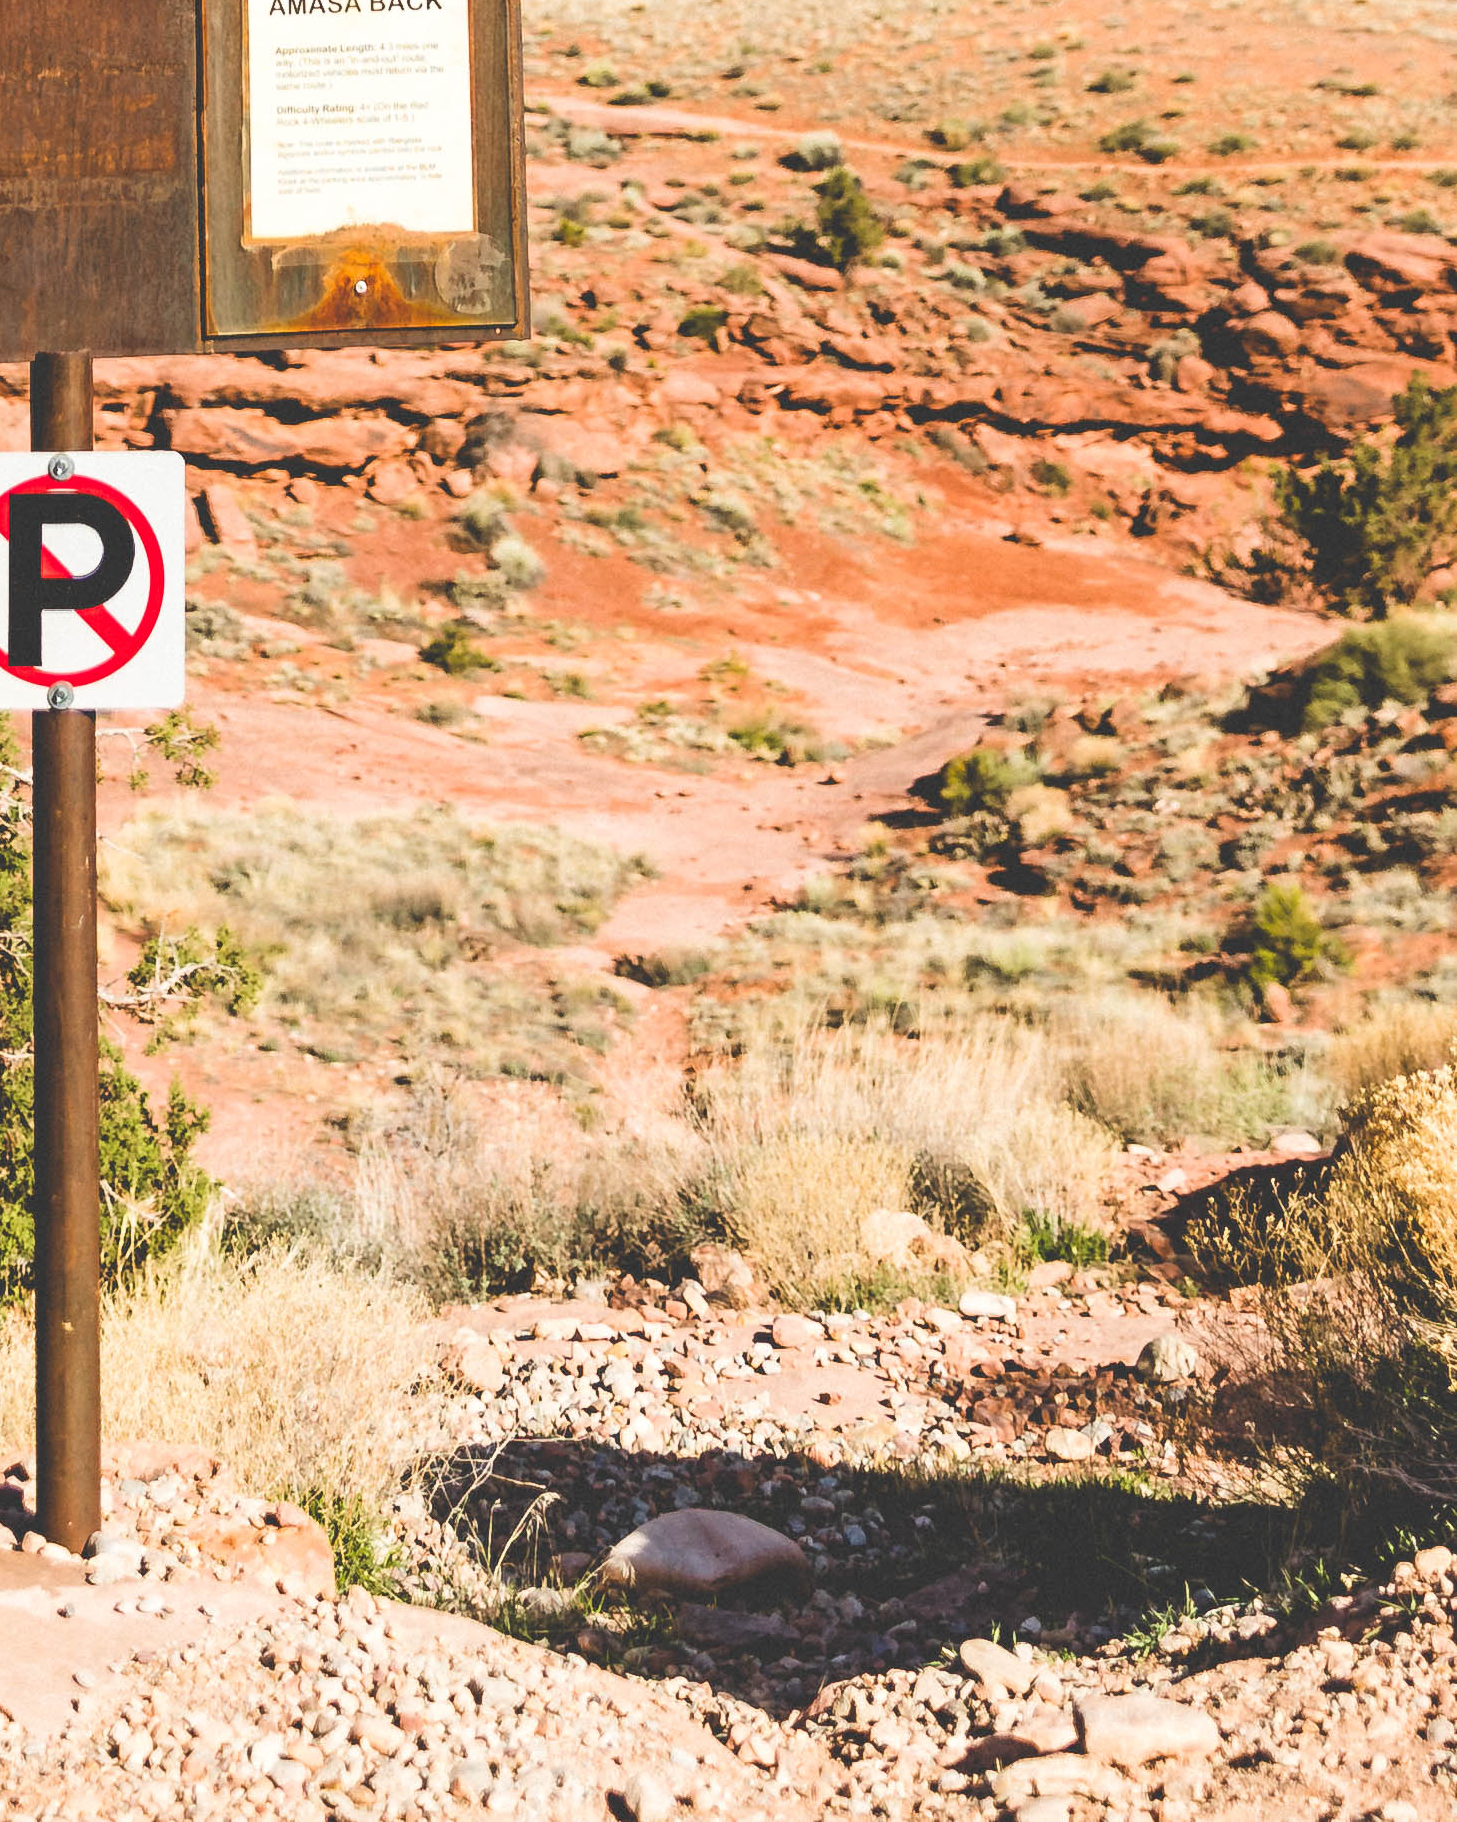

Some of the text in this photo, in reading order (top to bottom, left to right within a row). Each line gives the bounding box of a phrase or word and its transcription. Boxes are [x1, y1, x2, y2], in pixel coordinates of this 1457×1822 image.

[275, 44, 338, 56] Approximate
[276, 103, 320, 116] Difficulty
[7, 493, 135, 667] P
